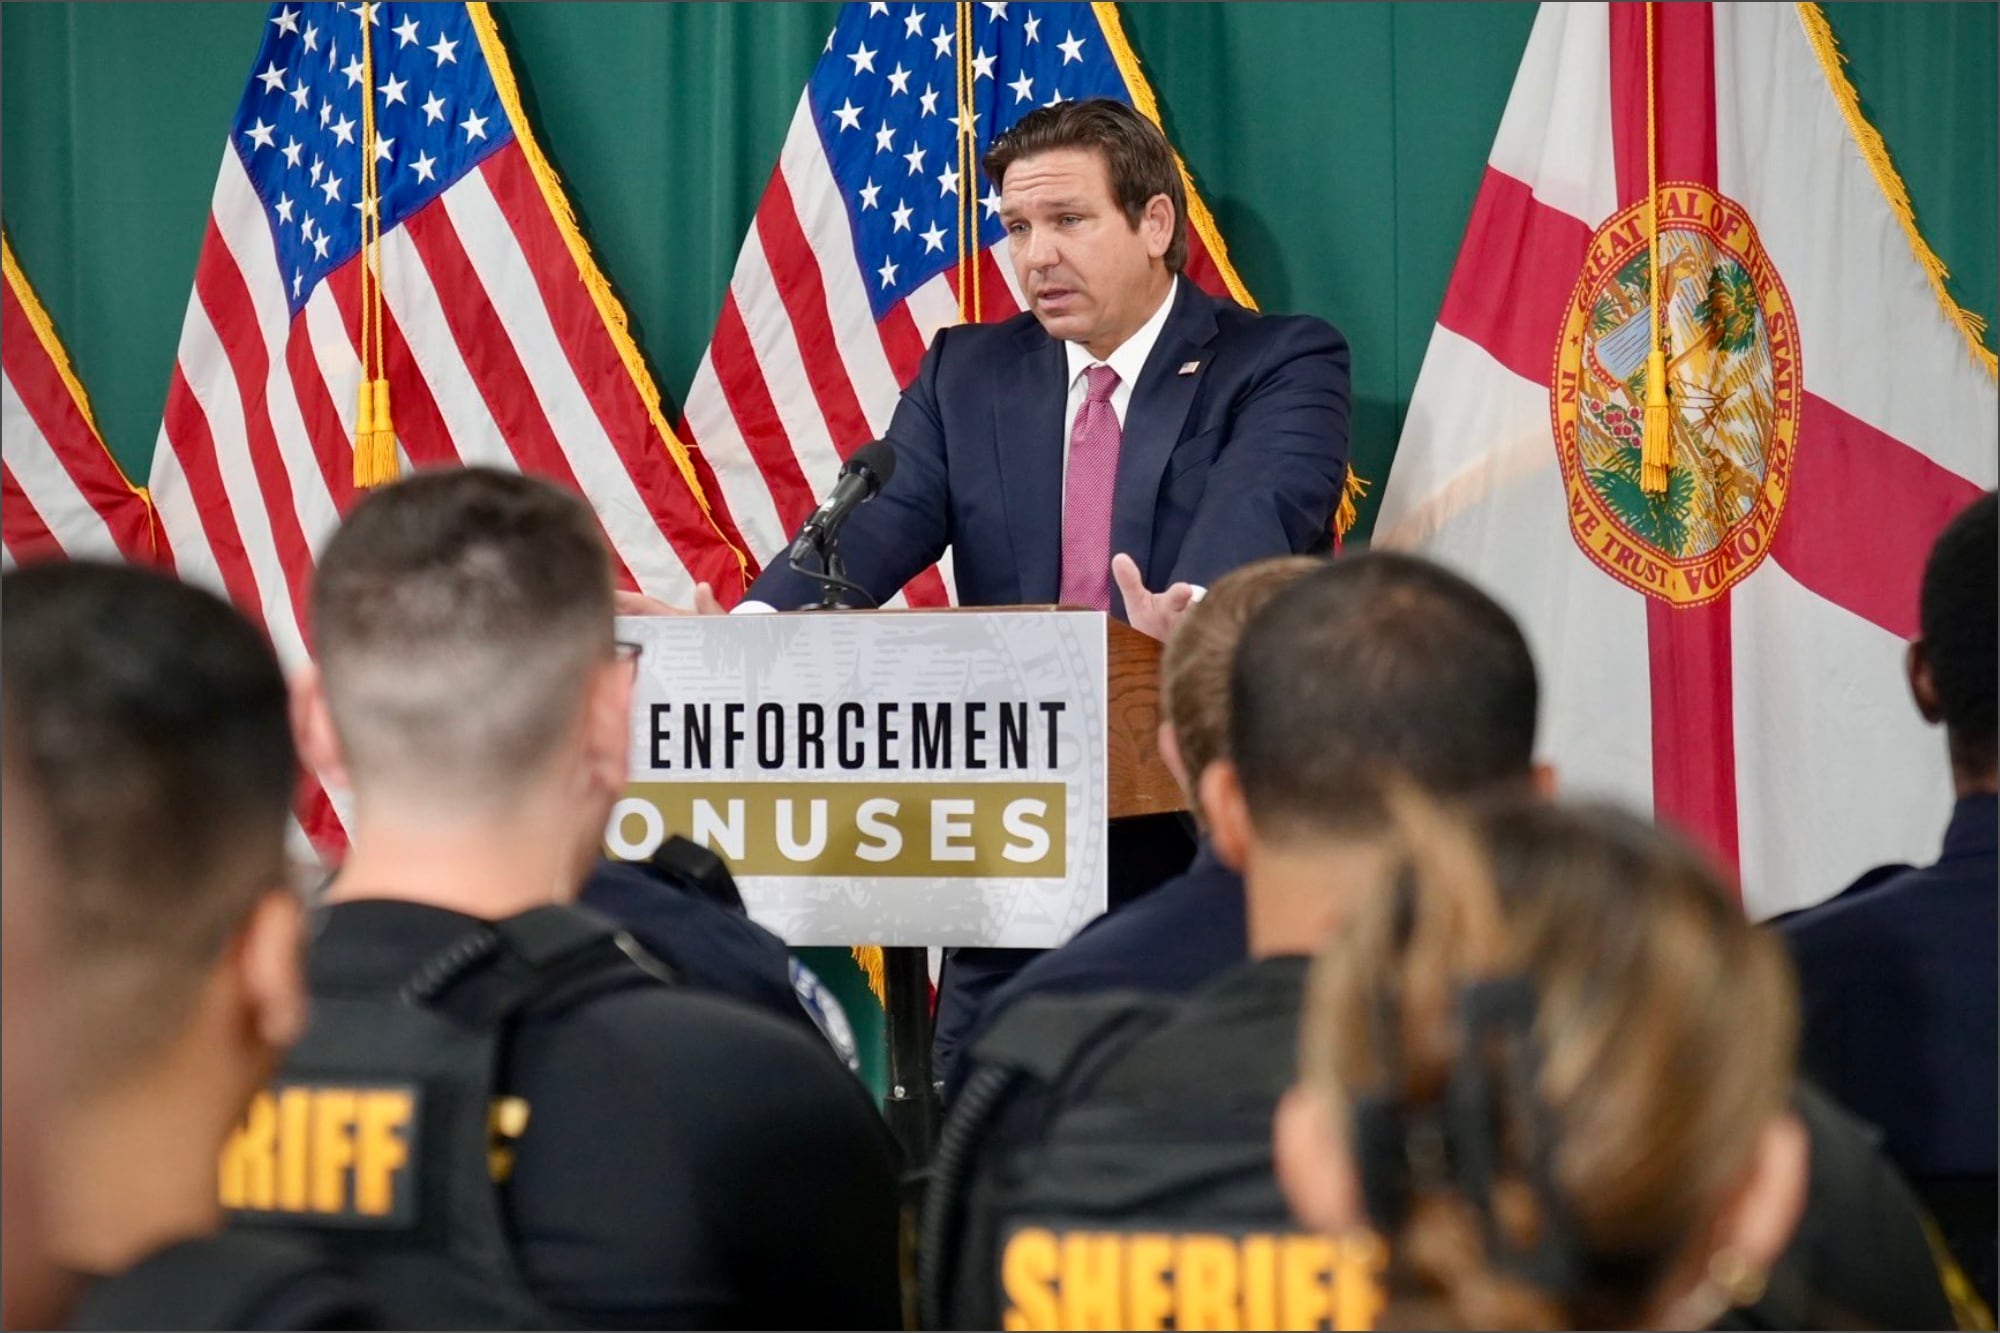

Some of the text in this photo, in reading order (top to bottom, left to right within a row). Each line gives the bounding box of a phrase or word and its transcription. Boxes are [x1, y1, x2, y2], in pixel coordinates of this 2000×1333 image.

[1578, 214, 1643, 312] GREAT
[1710, 203, 1742, 240] OF
[1768, 311, 1794, 422] STATE
[1561, 369, 1577, 403] IN
[1571, 488, 1601, 537] WE
[1600, 531, 1669, 588] TRUST
[1772, 437, 1788, 491] OF
[1683, 494, 1776, 595] FLORIDA
[650, 702, 1066, 769] ENFORCEMENT
[605, 798, 1051, 862] ONUSES
[219, 1086, 413, 1216] RIFF
